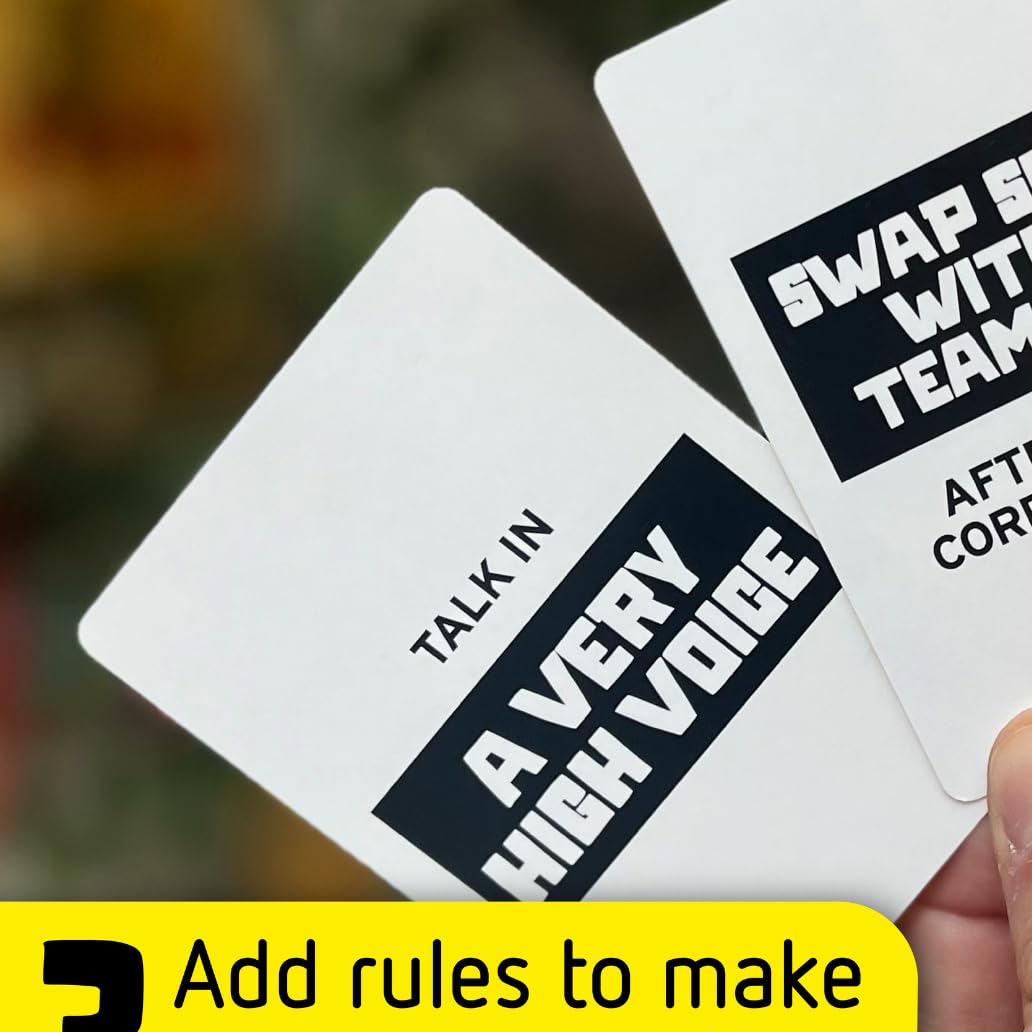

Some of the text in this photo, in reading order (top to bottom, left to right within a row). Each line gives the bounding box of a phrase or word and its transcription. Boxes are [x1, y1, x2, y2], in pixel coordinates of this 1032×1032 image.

[767, 184, 978, 328] SWAP
[409, 508, 554, 664] TALK IN
[463, 524, 701, 809] A VERY
[481, 524, 820, 901] HIGH VOICE
